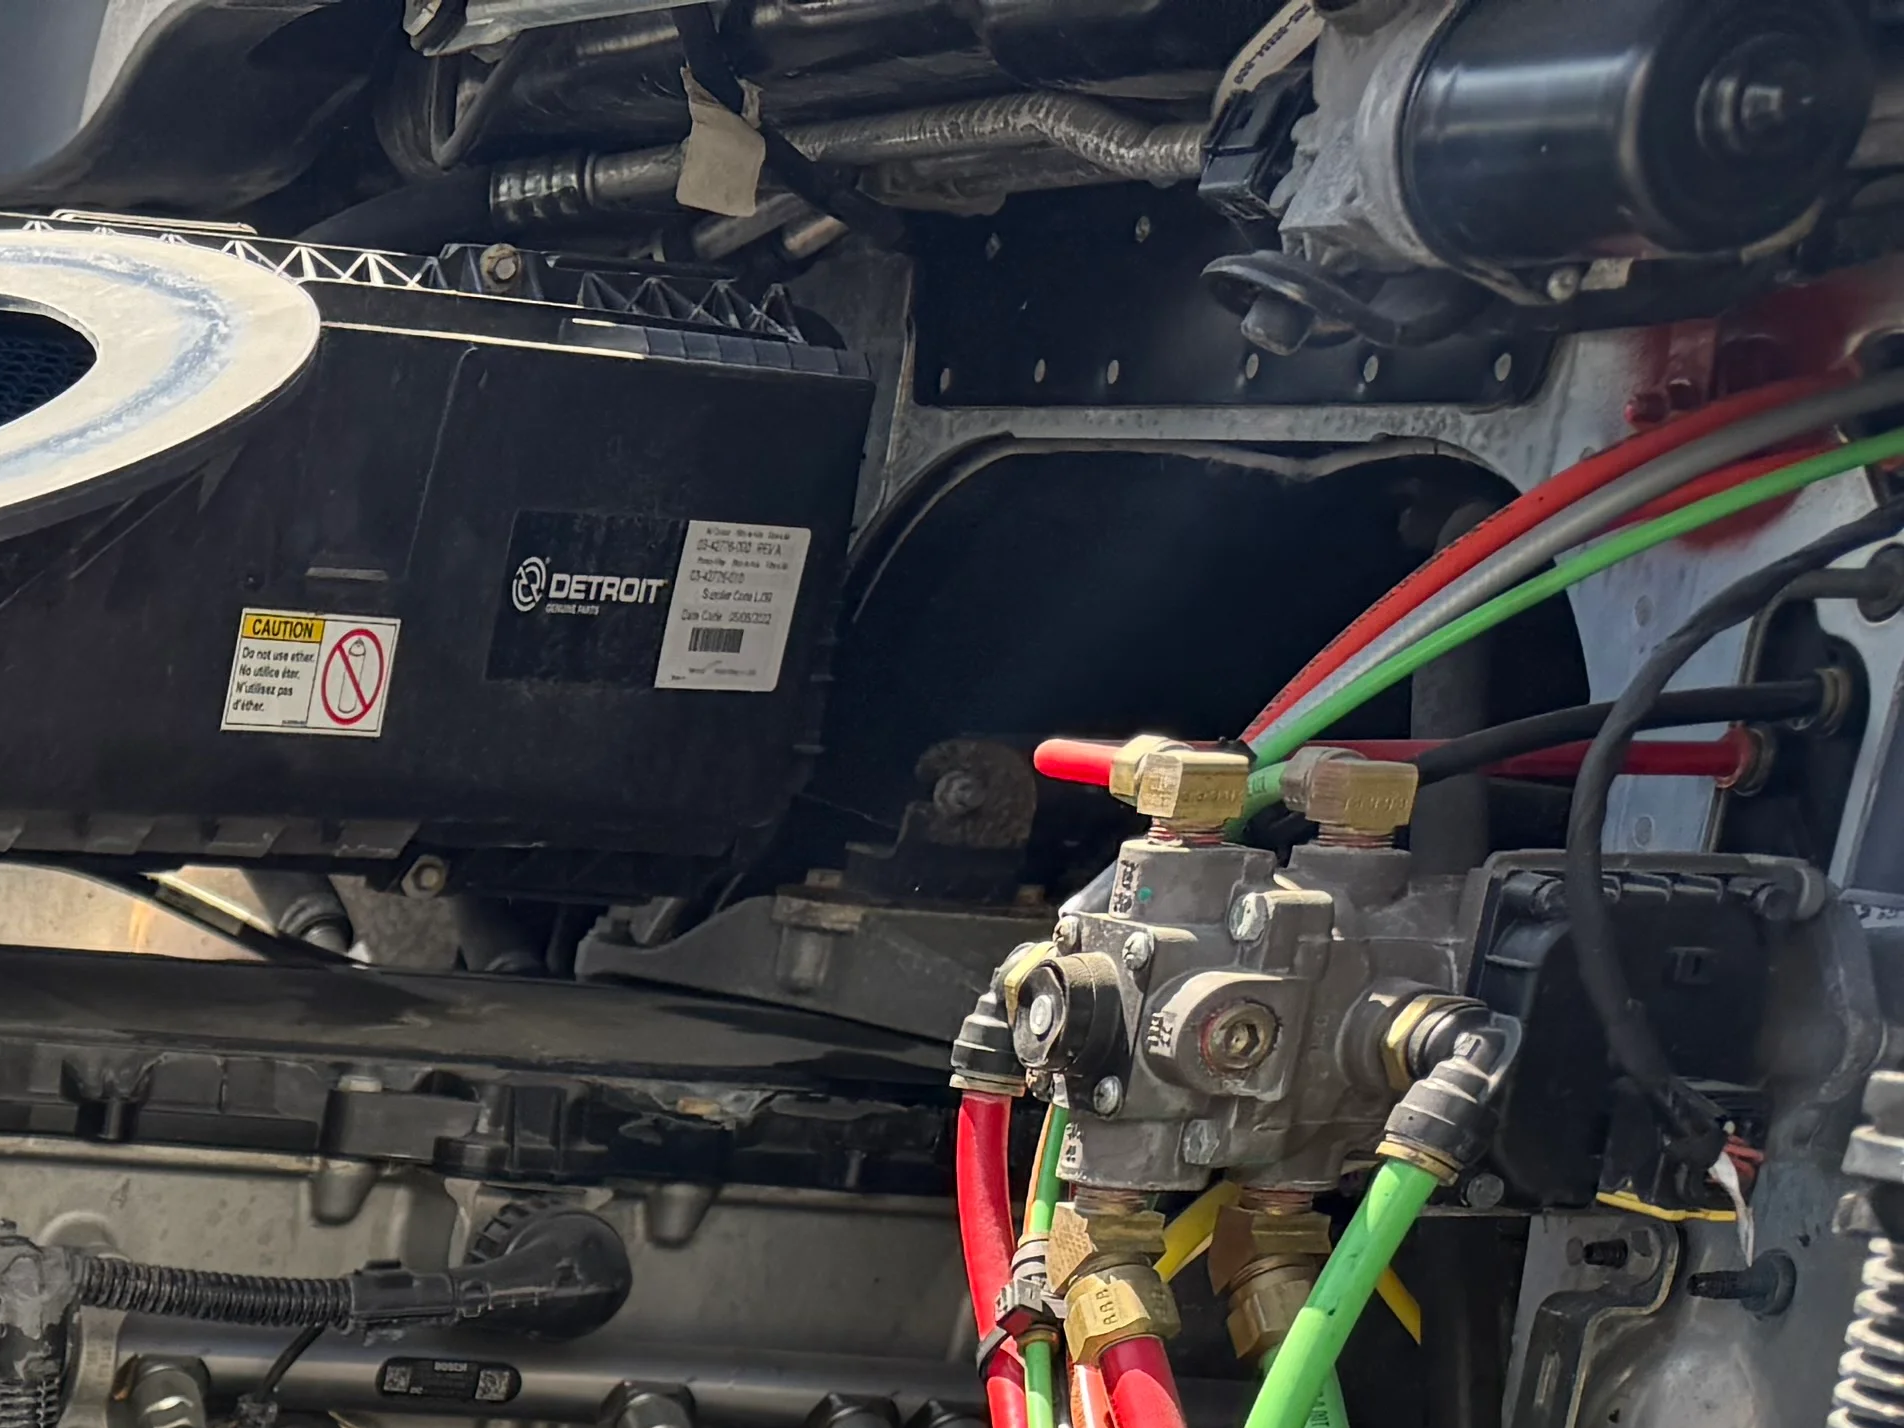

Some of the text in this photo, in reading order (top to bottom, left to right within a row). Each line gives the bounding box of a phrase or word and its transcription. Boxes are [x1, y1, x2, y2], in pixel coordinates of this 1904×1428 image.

[549, 573, 665, 603] DETROIT
[252, 619, 314, 638] CAUTION
[242, 647, 254, 658] Do
[256, 650, 271, 660] not
[273, 651, 288, 661] use
[239, 664, 250, 675] No
[277, 687, 293, 700] pas
